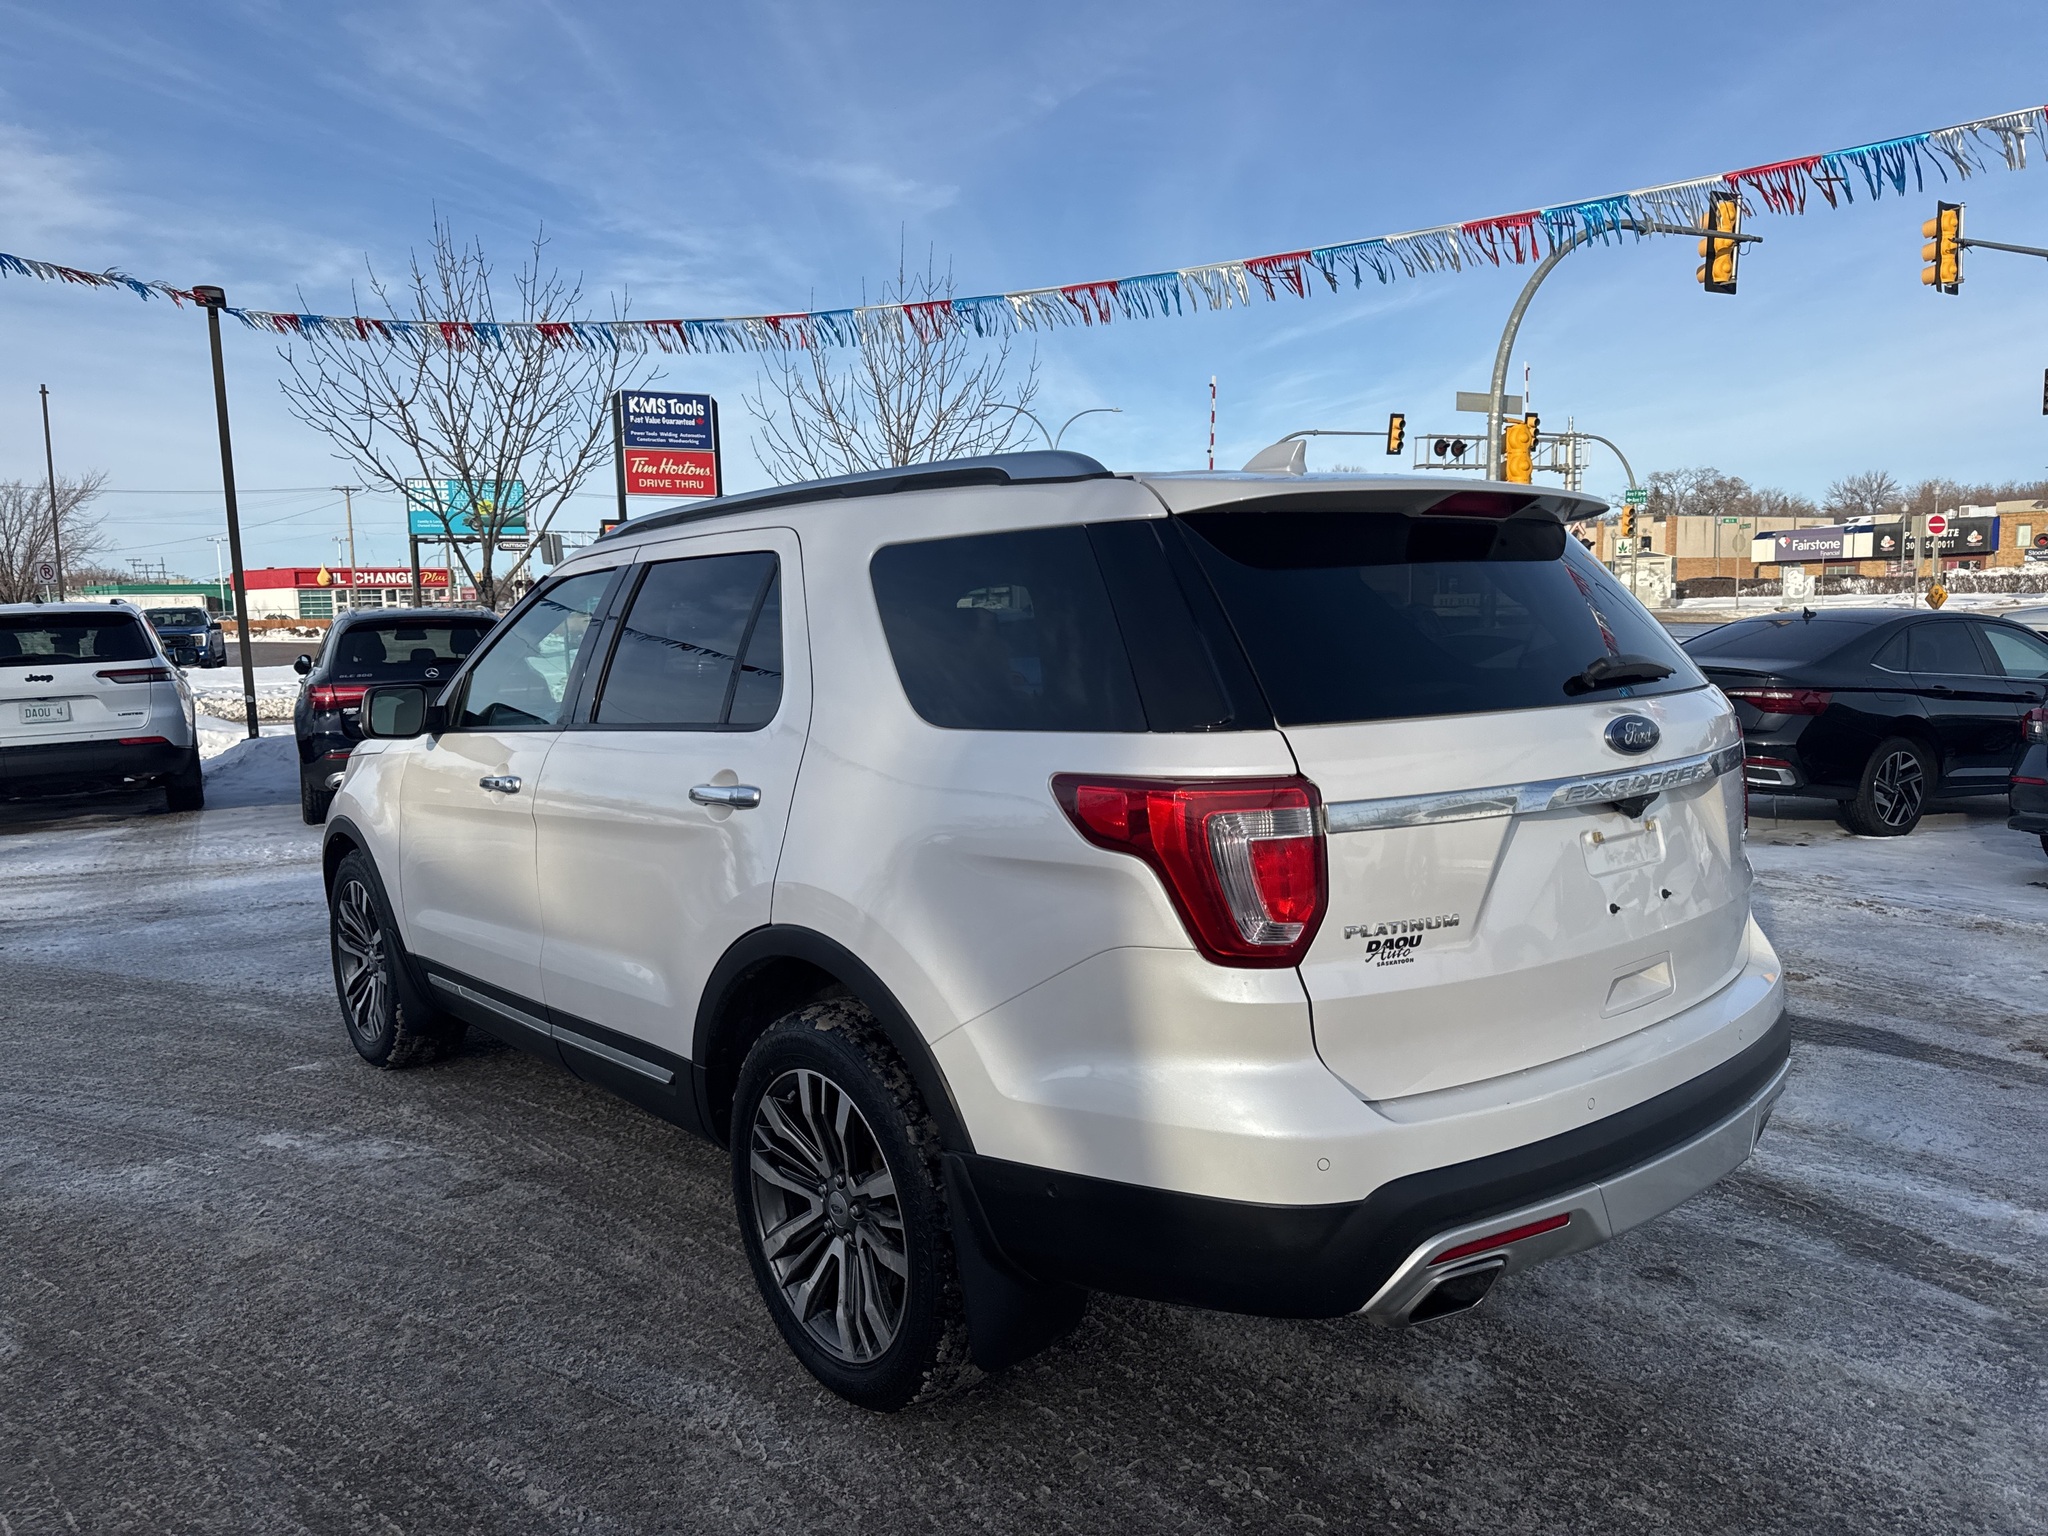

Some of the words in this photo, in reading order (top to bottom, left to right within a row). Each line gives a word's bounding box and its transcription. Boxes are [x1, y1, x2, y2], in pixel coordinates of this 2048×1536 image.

[628, 396, 667, 415] KMS
[667, 398, 705, 416] Tools
[644, 415, 662, 425] Value
[661, 416, 696, 426] Guaranteed
[630, 457, 657, 474] Tim
[659, 457, 711, 476] Hortons
[638, 478, 672, 488] DRIVE
[674, 479, 704, 489] THRU
[1792, 539, 1840, 551] Fairstone
[419, 571, 448, 584] Plus
[24, 674, 54, 682] Jeep
[25, 708, 51, 718] DAOU
[57, 707, 63, 716] 4
[1624, 721, 1653, 745] Ford
[1565, 763, 1707, 801] EXPLORER
[1344, 913, 1460, 940] PLATINUM
[1366, 934, 1423, 953] DAOU
[1365, 946, 1412, 963] Auto
[1376, 957, 1414, 967] SASKATOON
